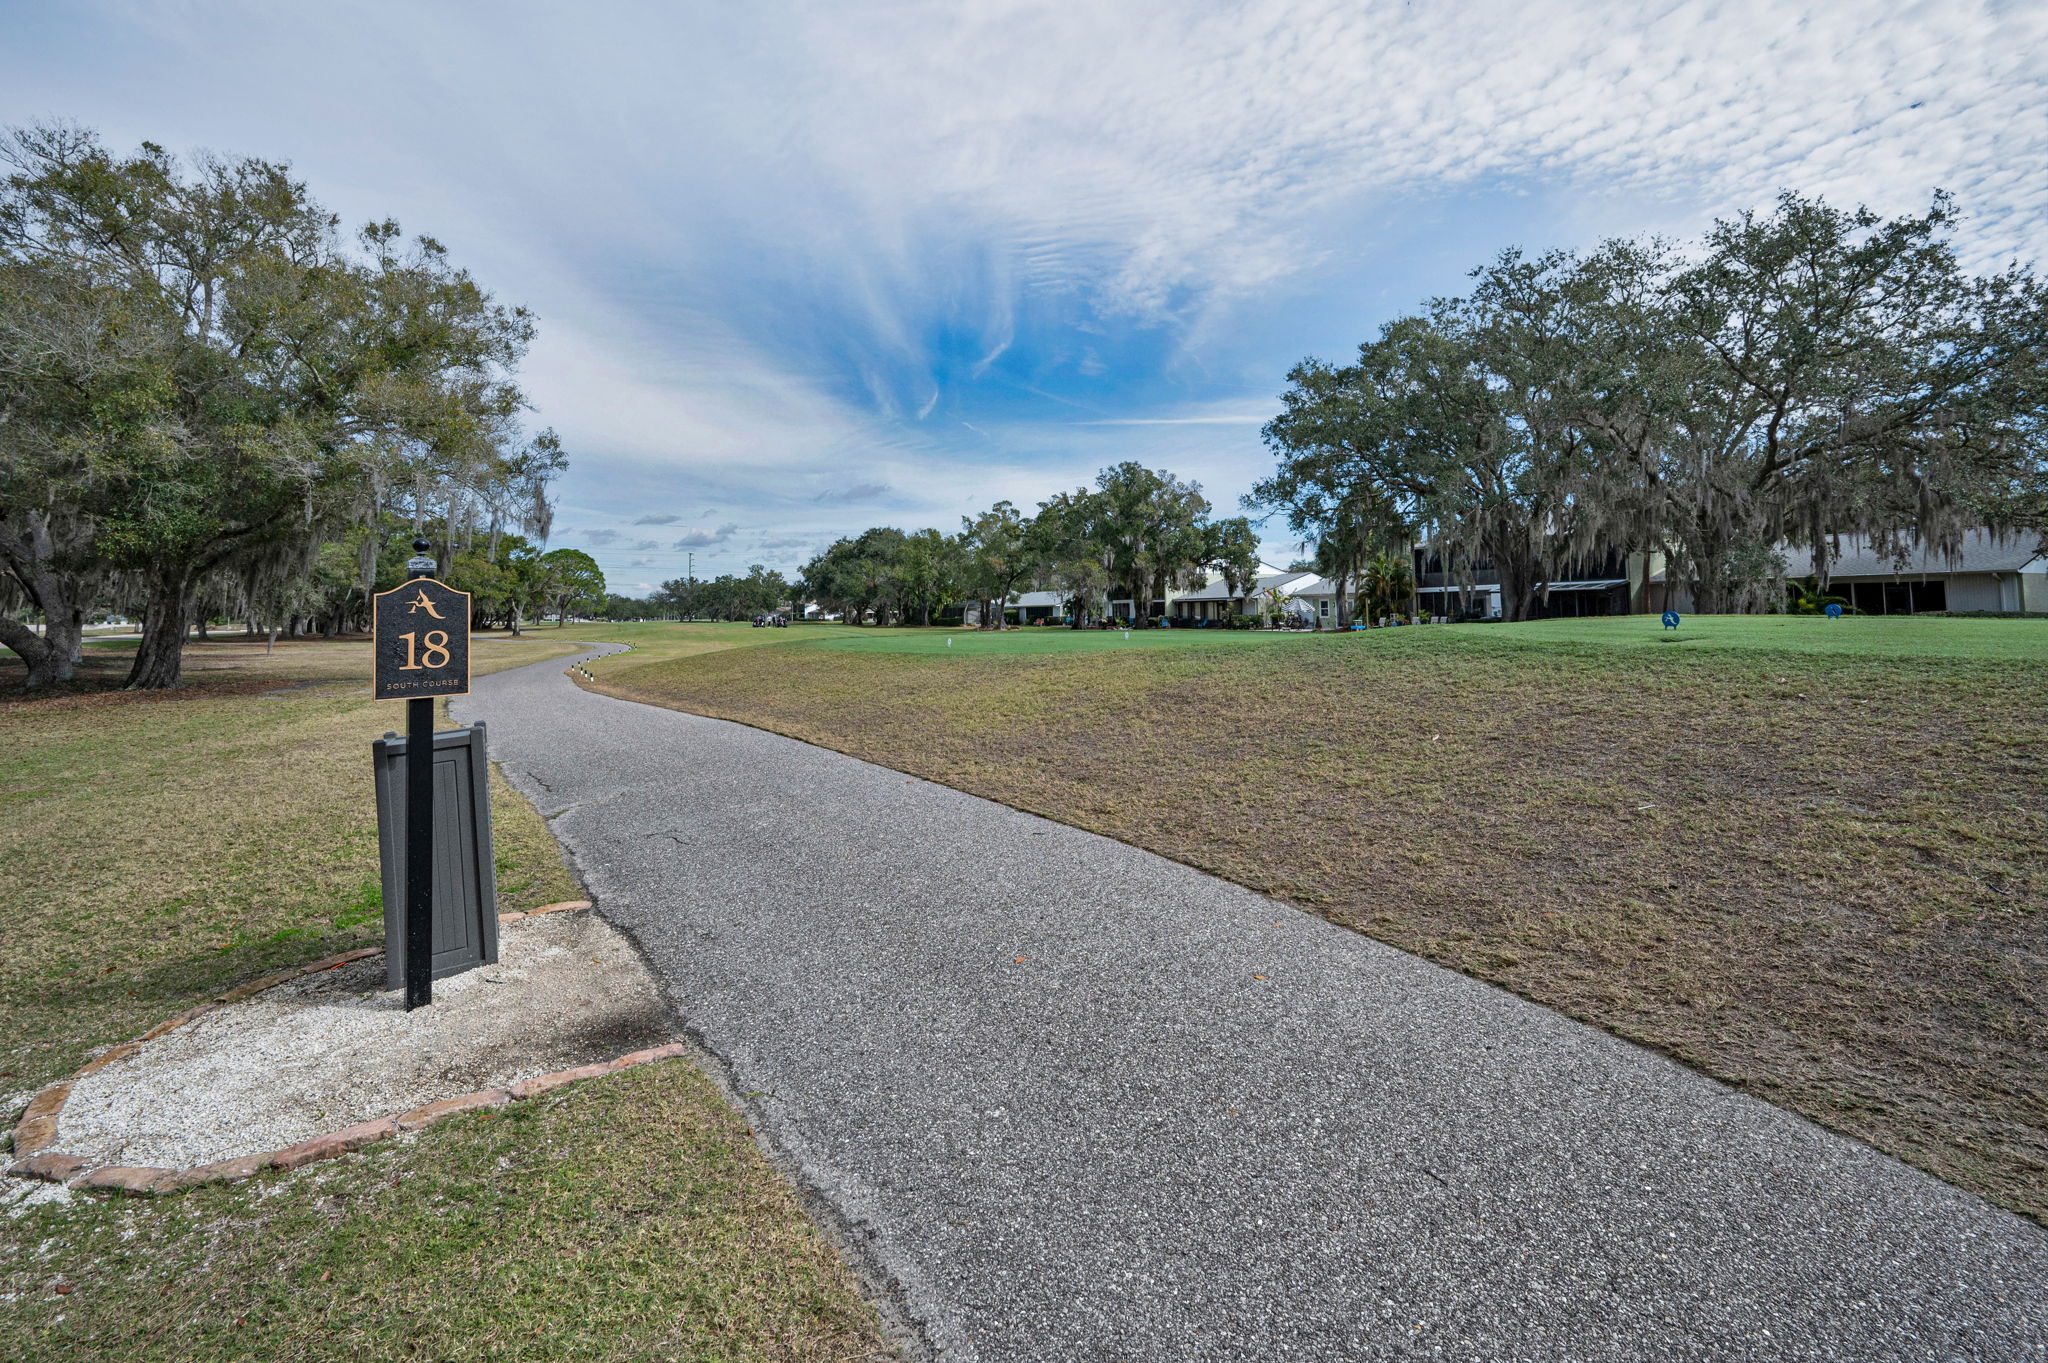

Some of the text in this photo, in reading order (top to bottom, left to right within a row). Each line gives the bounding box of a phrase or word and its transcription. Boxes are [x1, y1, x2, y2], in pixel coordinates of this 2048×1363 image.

[399, 630, 450, 670] 18
[387, 679, 459, 690] SOUTH COURSE
